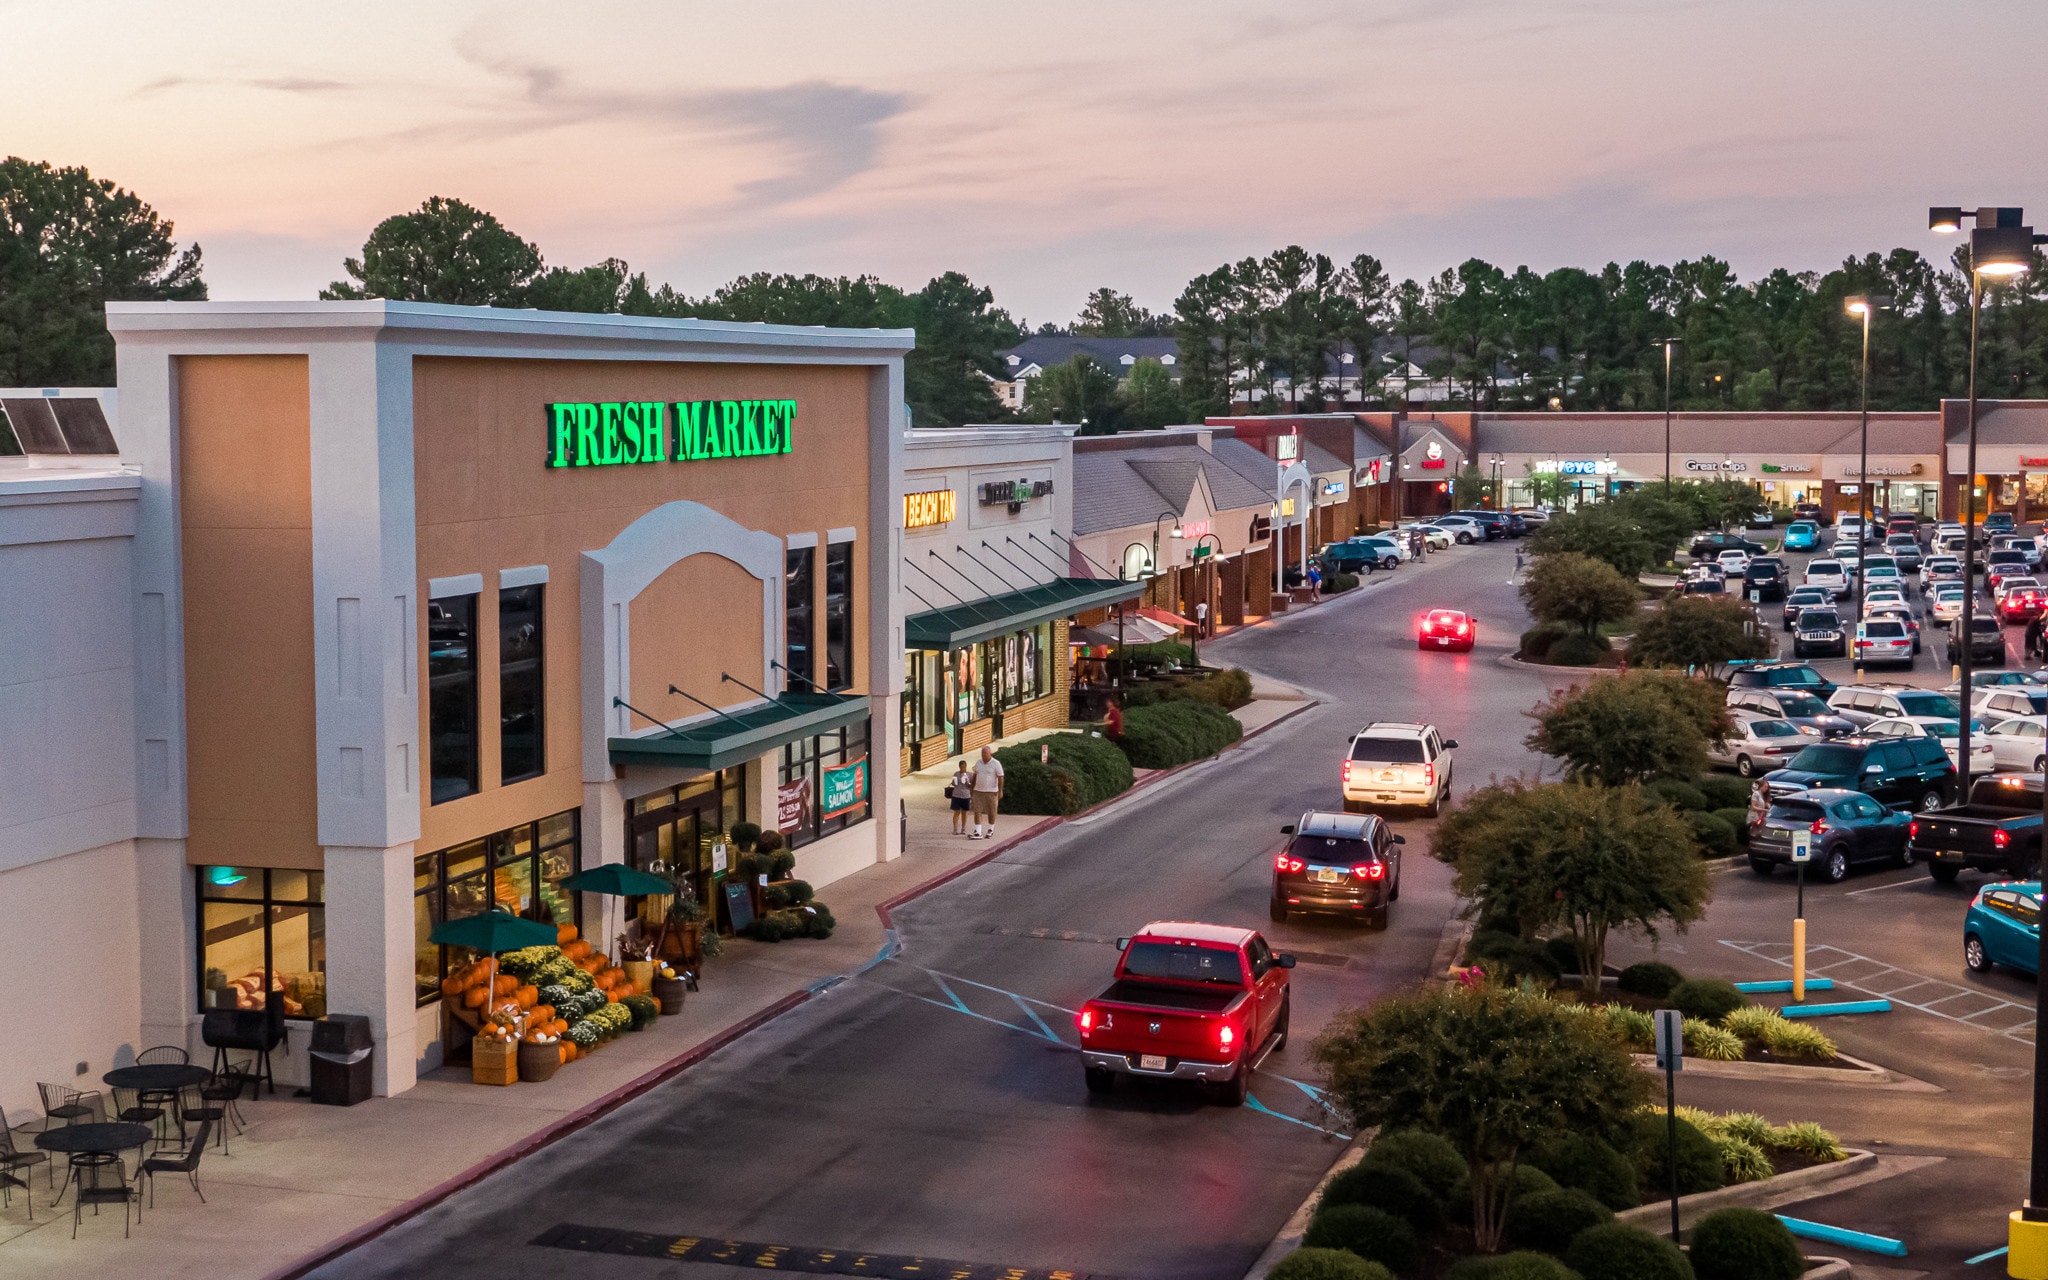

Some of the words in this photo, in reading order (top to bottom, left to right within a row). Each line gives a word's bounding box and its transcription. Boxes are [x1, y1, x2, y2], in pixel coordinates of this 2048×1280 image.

[547, 401, 667, 468] FRESH
[672, 400, 797, 462] MARKET
[1686, 460, 1718, 471] Great
[1720, 460, 1746, 473] Clips
[907, 492, 938, 527] BEACH
[939, 490, 957, 523] TAN
[828, 788, 853, 808] SALMON
